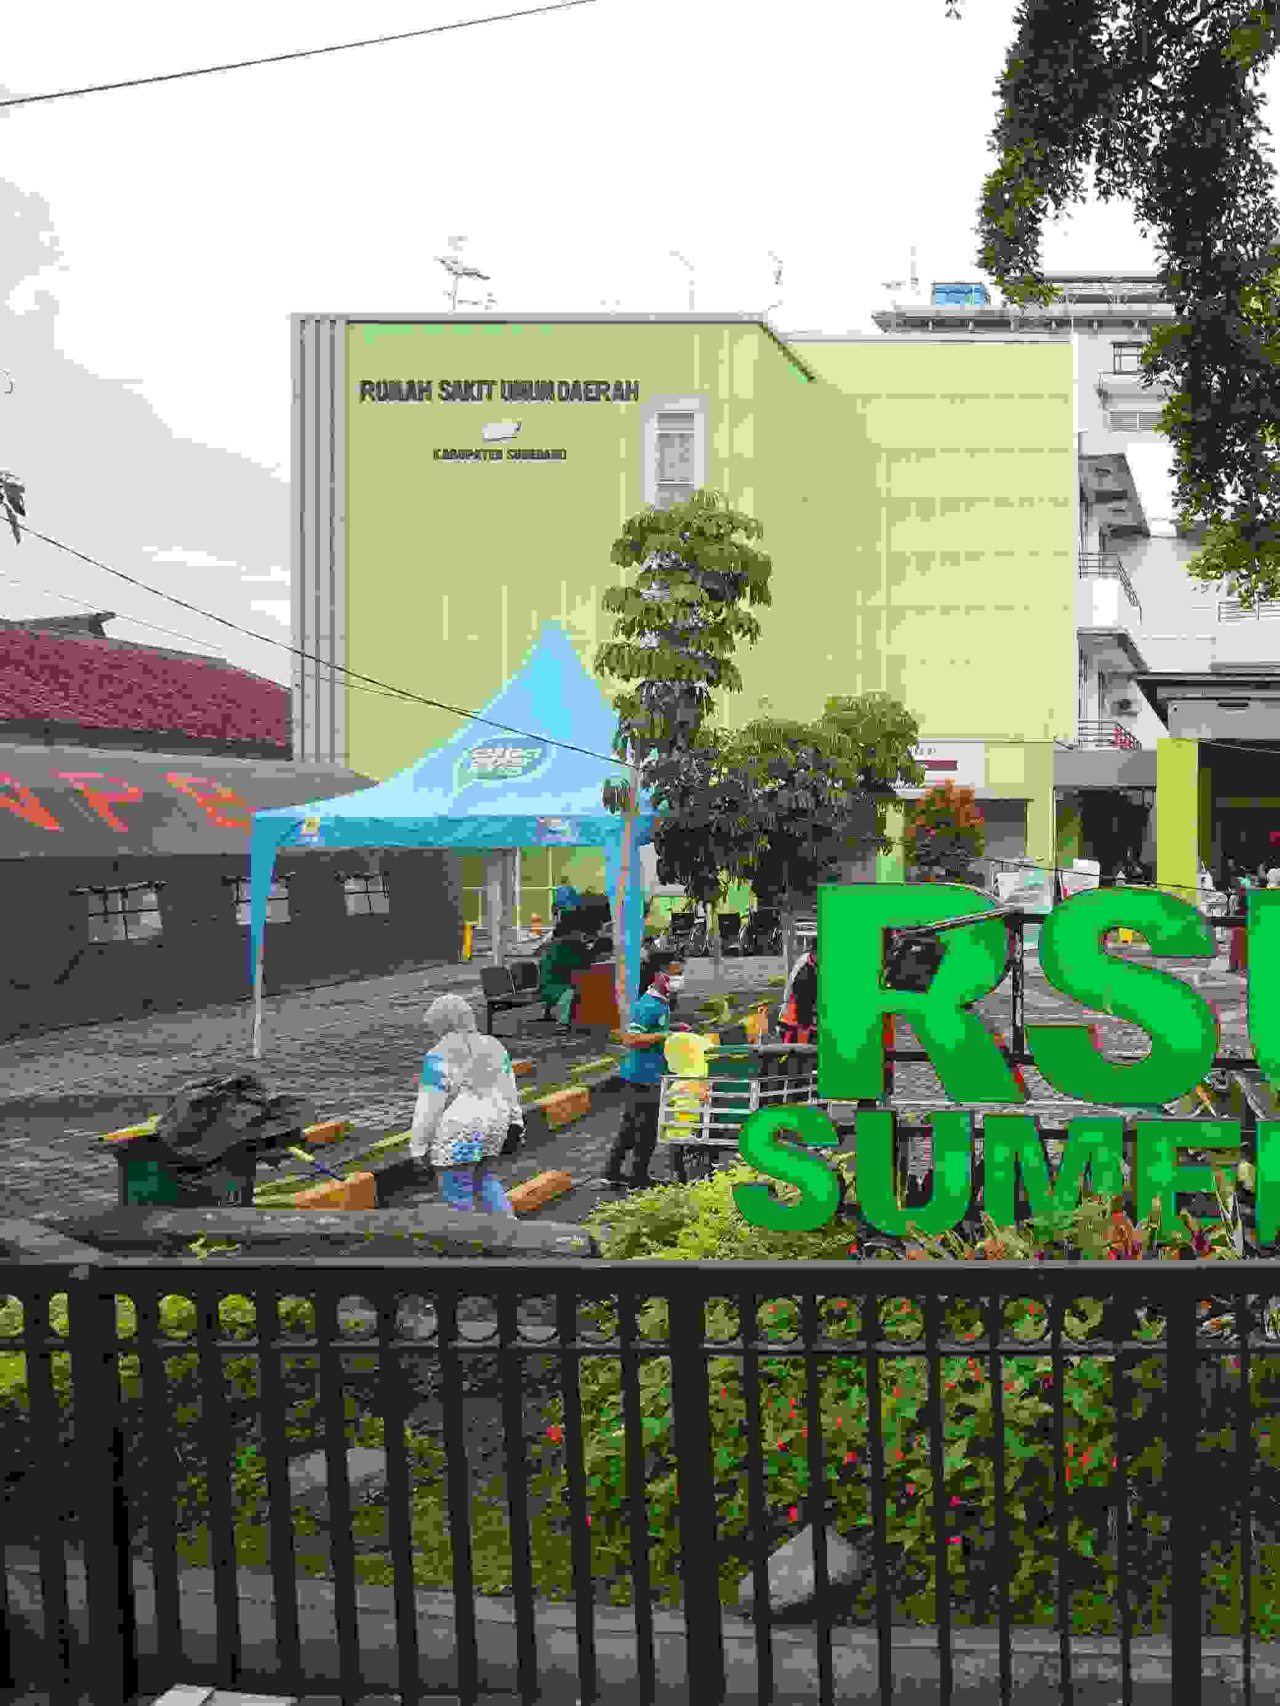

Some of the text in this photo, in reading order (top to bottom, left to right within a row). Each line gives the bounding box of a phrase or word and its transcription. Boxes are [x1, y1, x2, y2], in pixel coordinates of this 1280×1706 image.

[359, 379, 433, 403] RUMAH
[438, 379, 498, 403] SAKIT
[557, 379, 640, 403] DAERAH
